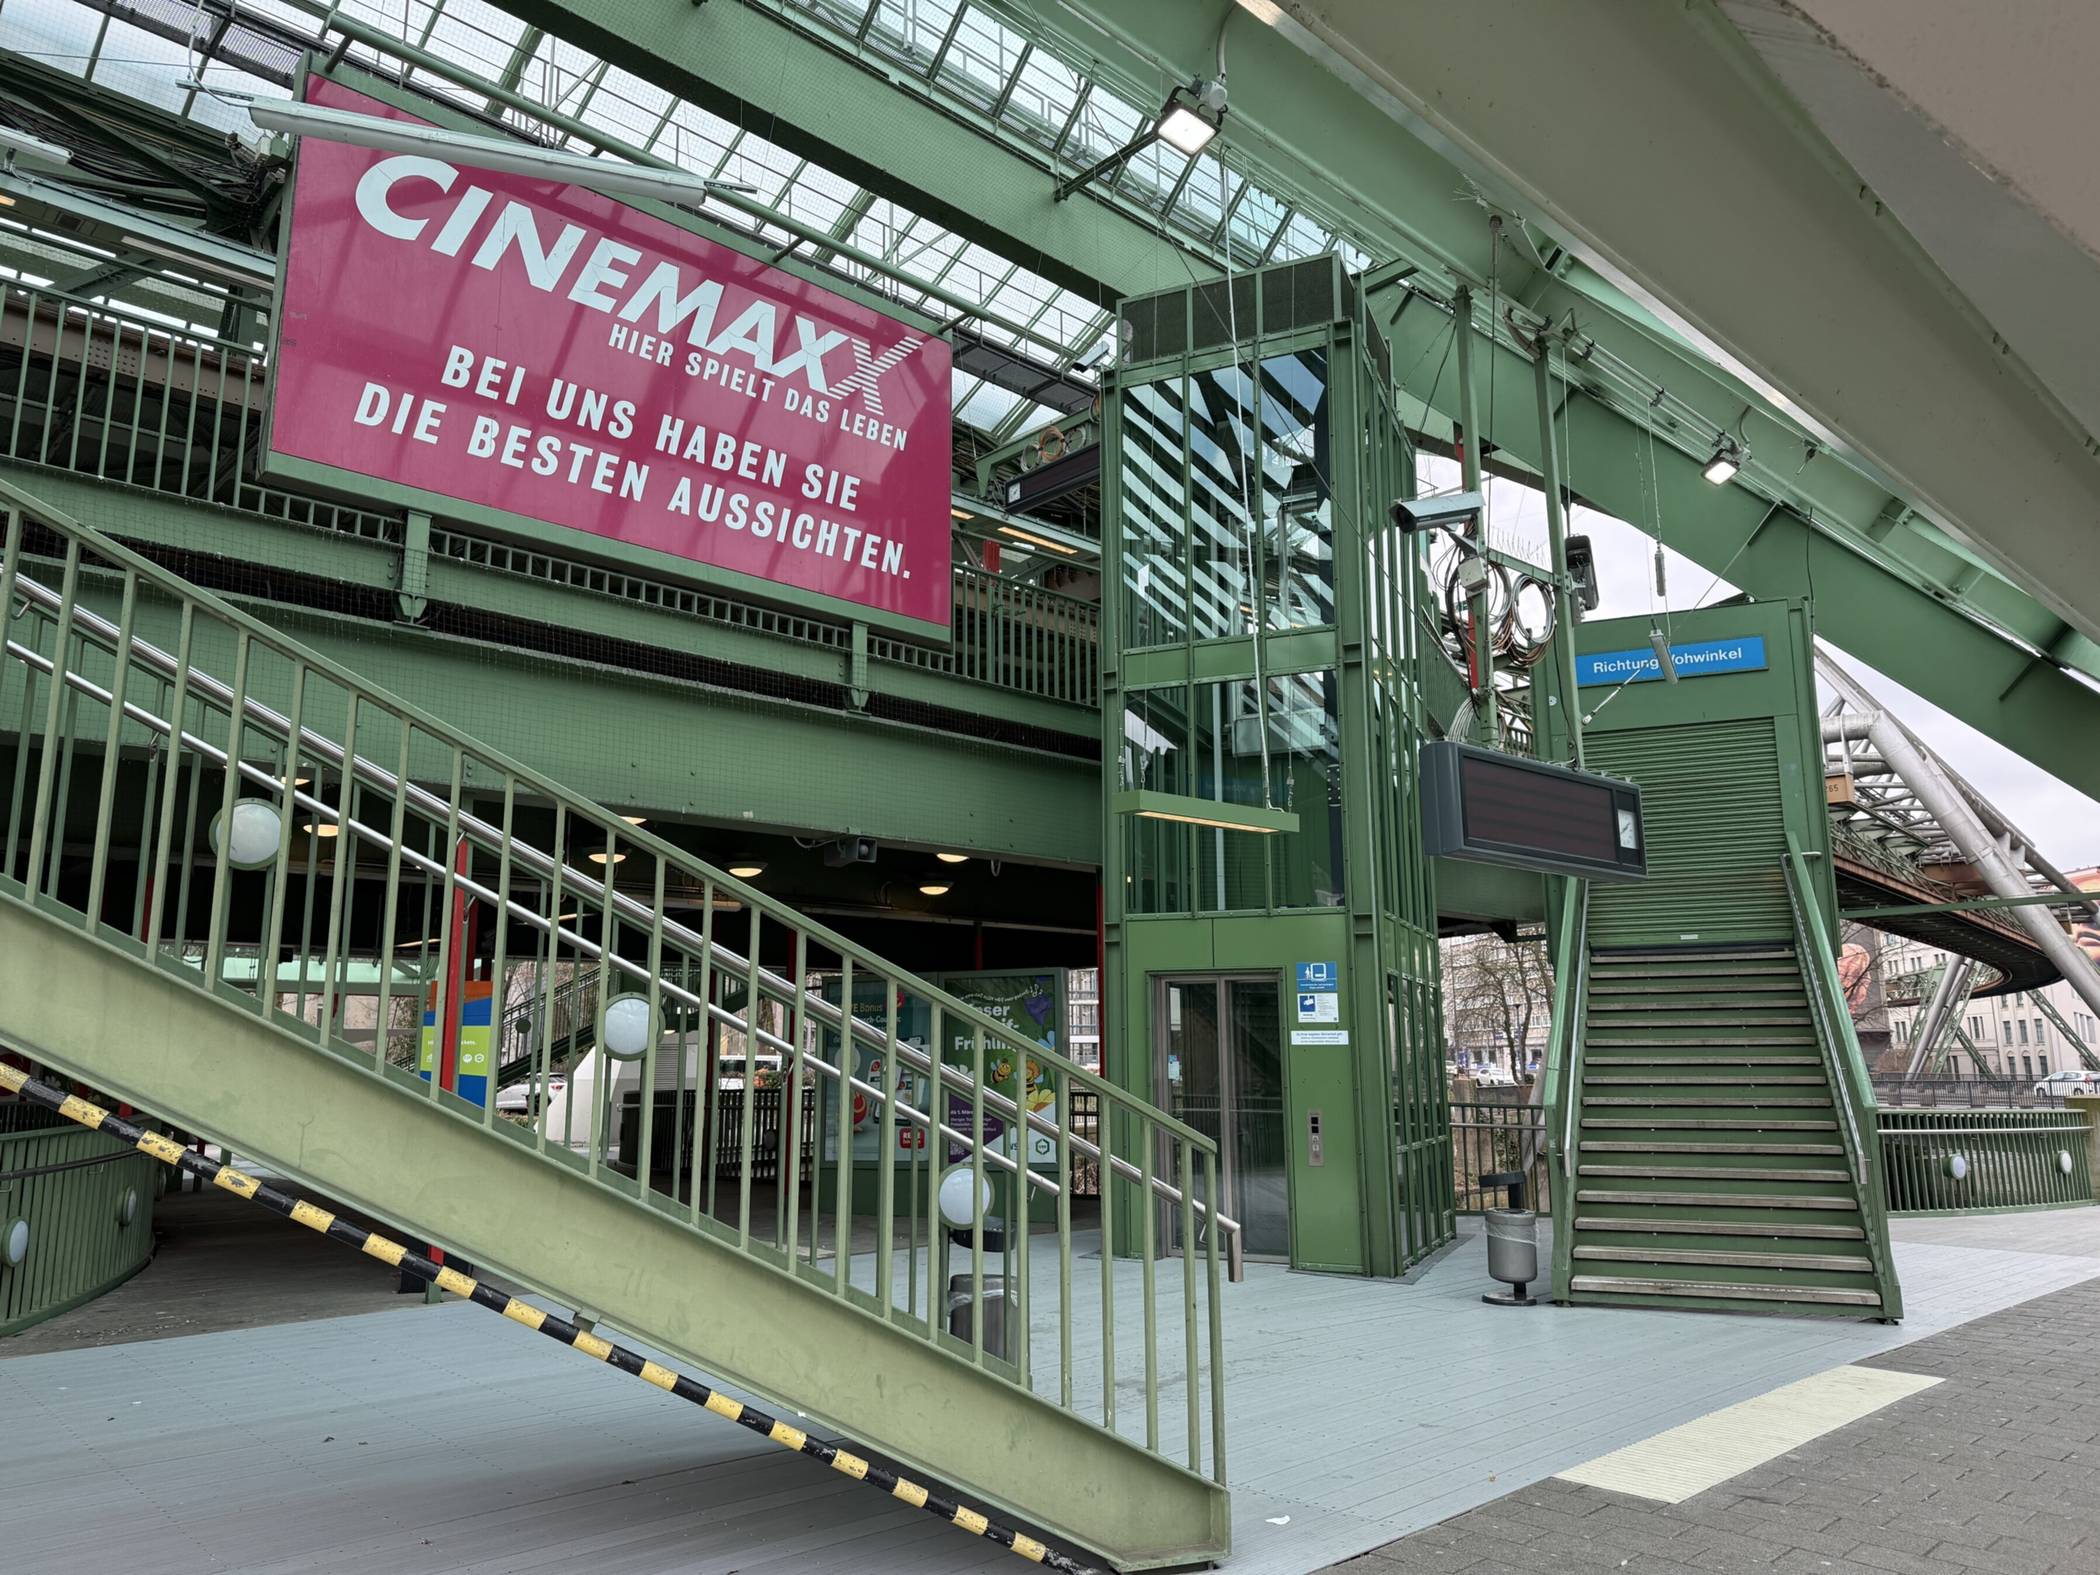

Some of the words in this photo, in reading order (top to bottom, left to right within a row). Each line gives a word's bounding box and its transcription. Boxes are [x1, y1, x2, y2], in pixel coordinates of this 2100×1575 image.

[355, 154, 924, 417] CINEMAXX
[441, 344, 526, 406] BEI
[546, 378, 636, 439] UNS
[655, 414, 788, 488] HABEN
[801, 463, 861, 512] SIE
[608, 323, 674, 367] HIER
[685, 352, 776, 403] SPIELT
[783, 387, 831, 423] DAS
[839, 408, 908, 451] LEBEN
[353, 381, 448, 445] DIE
[466, 415, 650, 503] BESTEN
[666, 476, 912, 580] AUSSICHTEN.
[1593, 658, 1660, 674] Richtung
